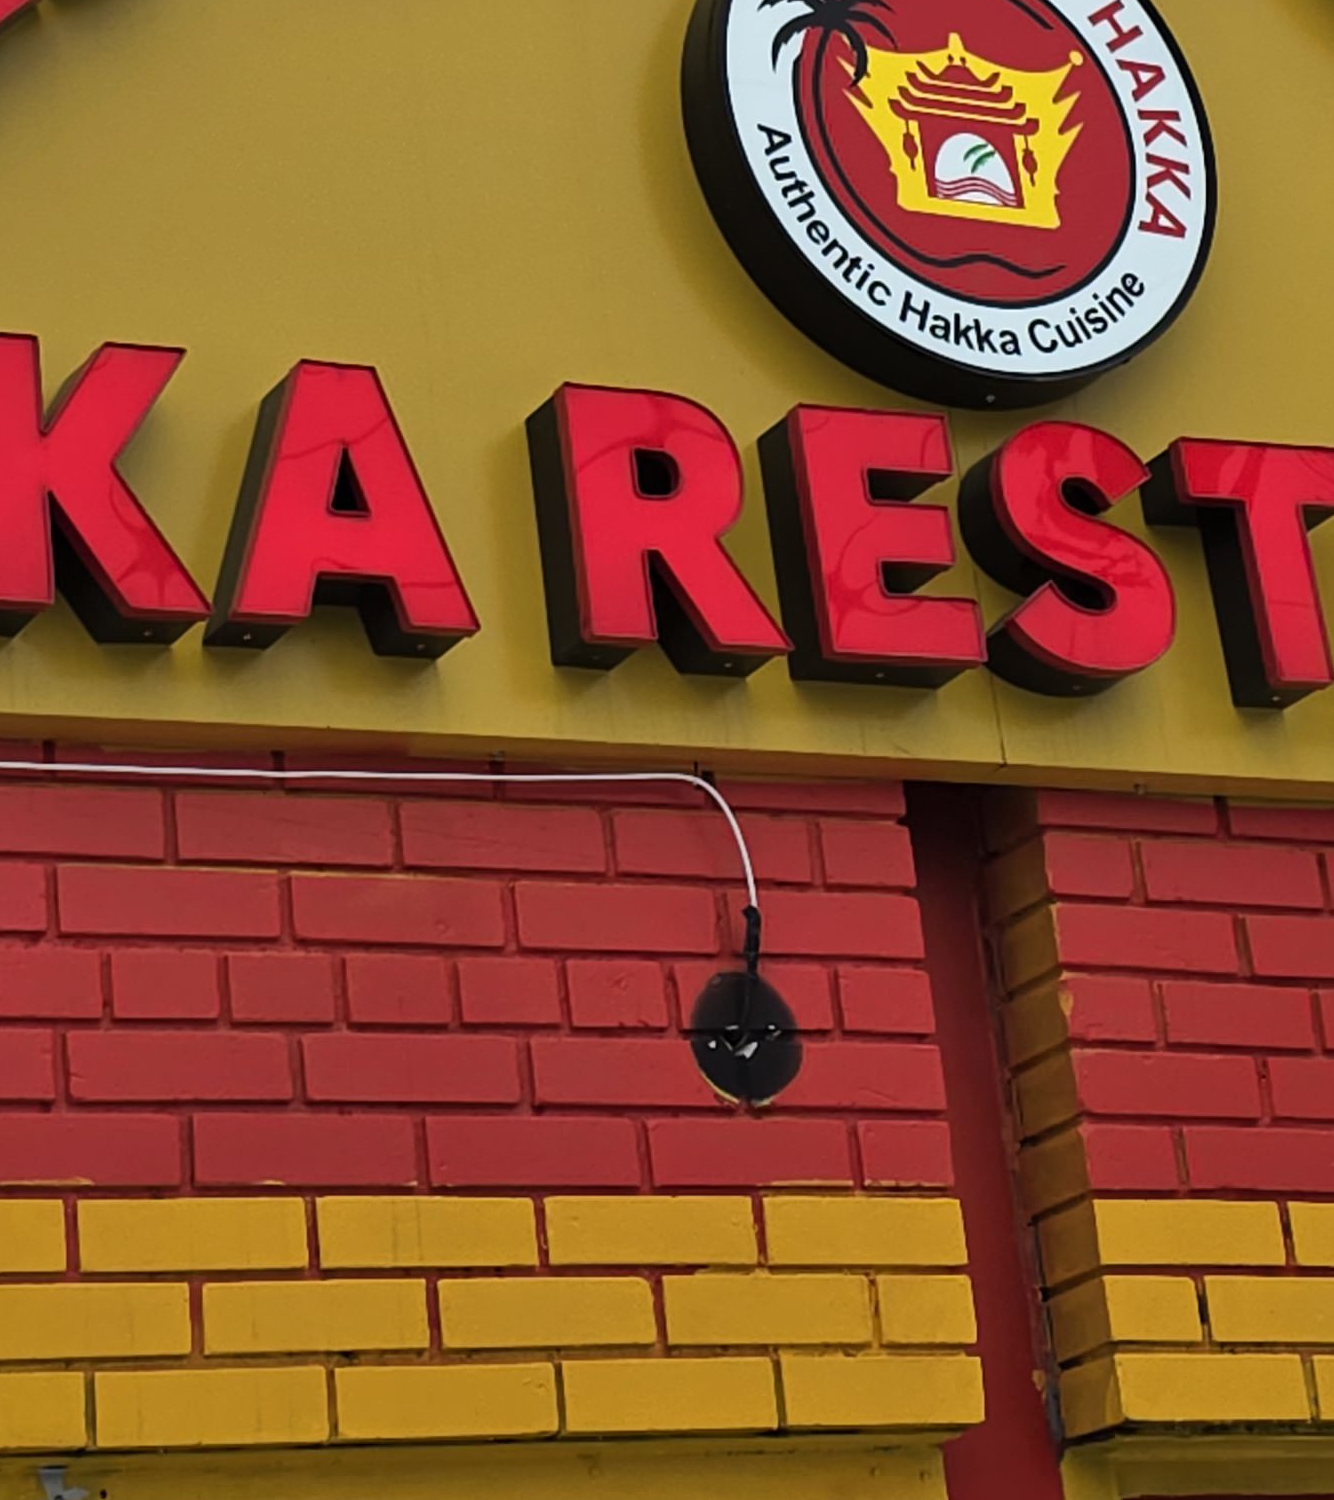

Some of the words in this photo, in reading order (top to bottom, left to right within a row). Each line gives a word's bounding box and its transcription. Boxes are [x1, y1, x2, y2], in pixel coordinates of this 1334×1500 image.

[757, 122, 892, 307] Authentic
[898, 289, 1022, 357] Hakka
[1027, 270, 1146, 354] Cuisine
